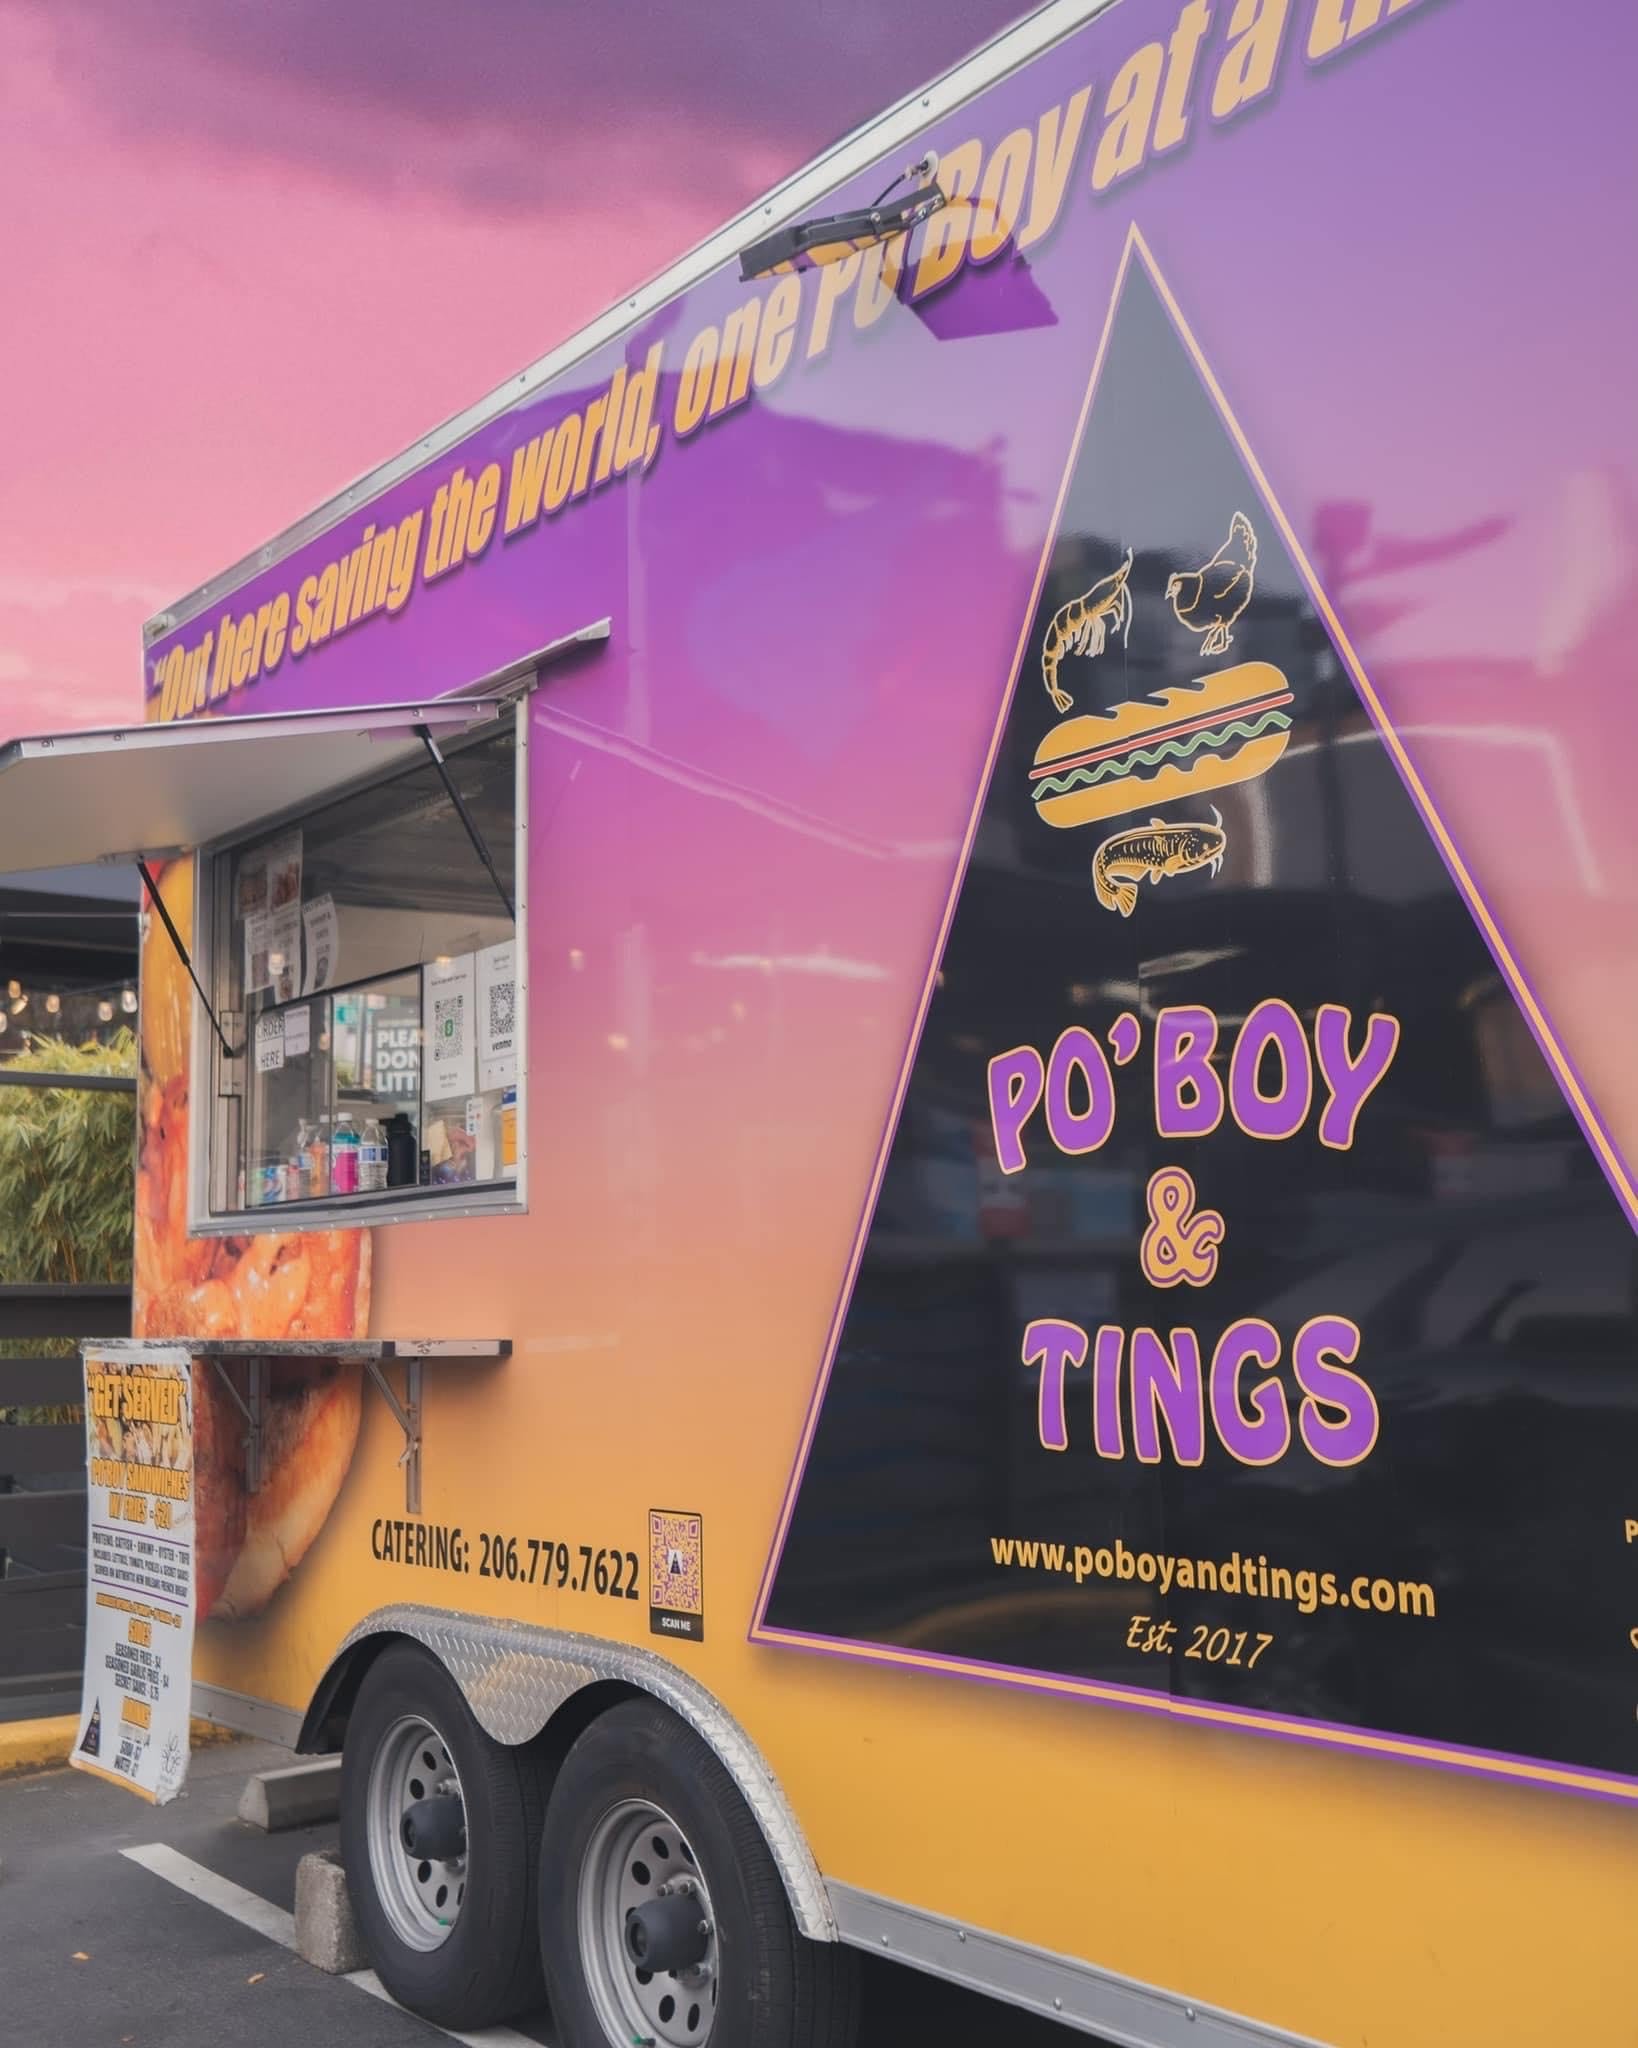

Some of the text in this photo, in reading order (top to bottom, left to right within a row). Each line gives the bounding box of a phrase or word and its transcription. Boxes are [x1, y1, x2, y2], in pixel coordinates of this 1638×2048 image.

[210, 592, 289, 699] here
[290, 507, 425, 655] saving
[423, 463, 502, 579] the
[503, 340, 664, 536] world,
[674, 274, 801, 433] one
[1091, 0, 1211, 190] at
[1211, 0, 1289, 117] a
[260, 1049, 280, 1068] HERE
[986, 997, 1401, 1174] PO'BOY
[1139, 1166, 1226, 1287] &
[1021, 1314, 1380, 1467] TINGS
[123, 1493, 147, 1524] FRIES
[126, 1461, 190, 1501] SANDWICHES
[372, 1519, 640, 1600] CATERING: 206.779.7622
[990, 1535, 1436, 1617] www.poboyandtings.com
[661, 1617, 691, 1632] SCAN ME
[1126, 1614, 1274, 1671] Est. 2017
